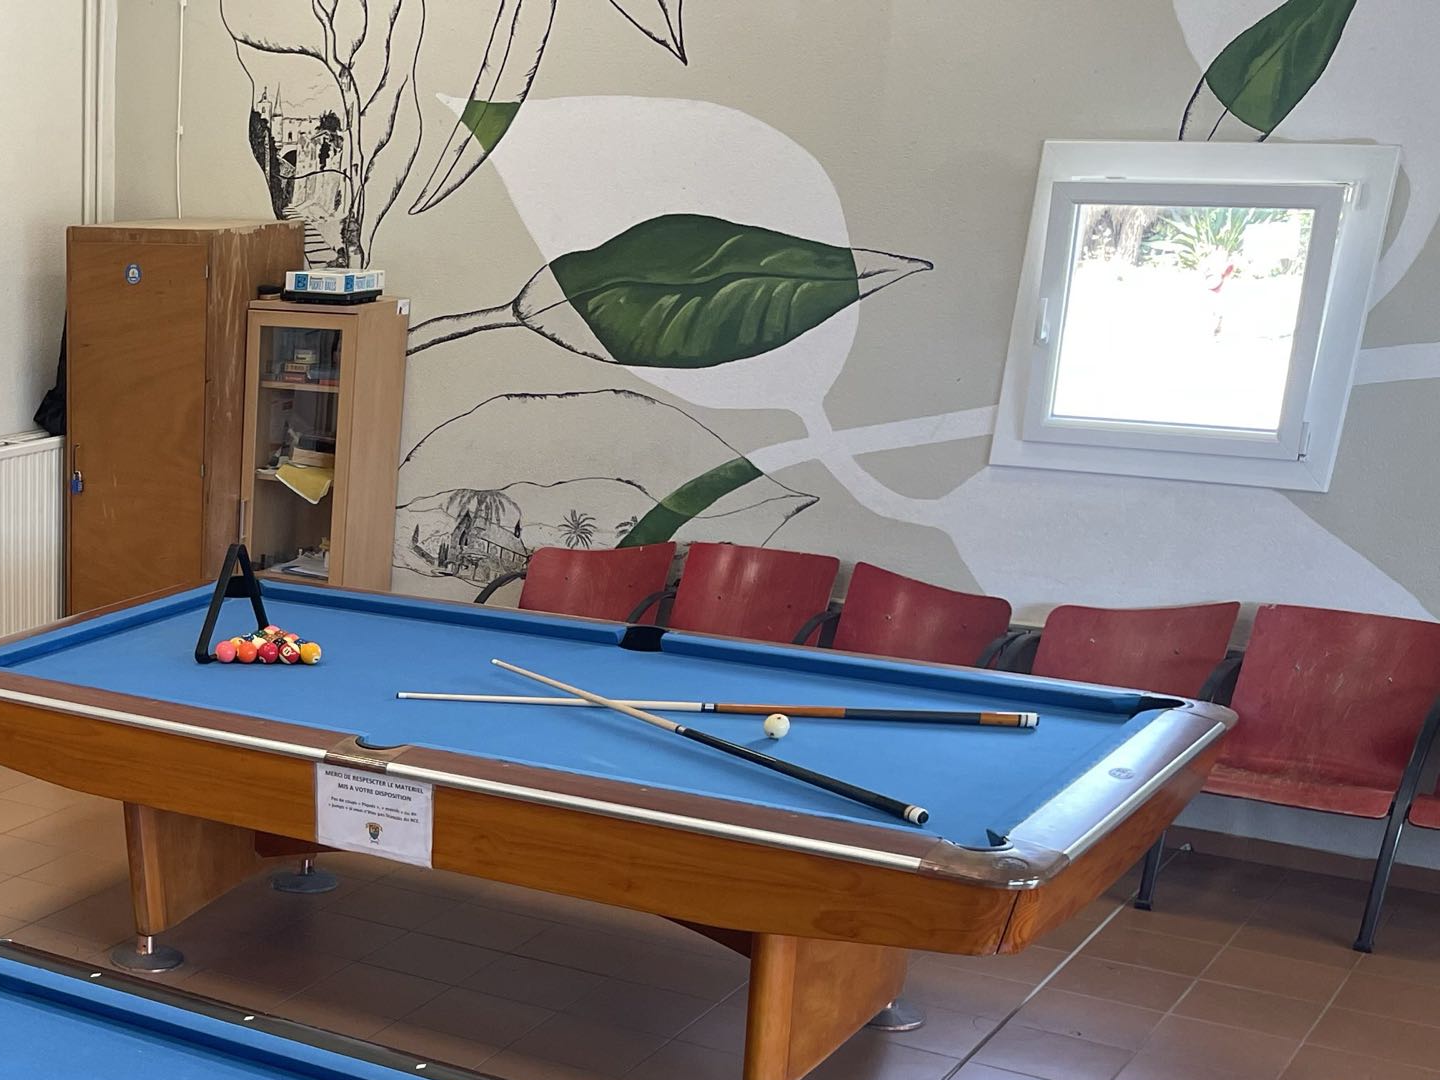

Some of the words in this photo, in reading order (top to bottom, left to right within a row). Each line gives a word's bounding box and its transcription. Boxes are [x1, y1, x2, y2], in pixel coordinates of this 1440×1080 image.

[325, 770, 343, 779] MERCI
[394, 783, 424, 794] MATERIEL
[355, 786, 374, 795] VOTRE
[374, 790, 412, 802] DISPOSITION
